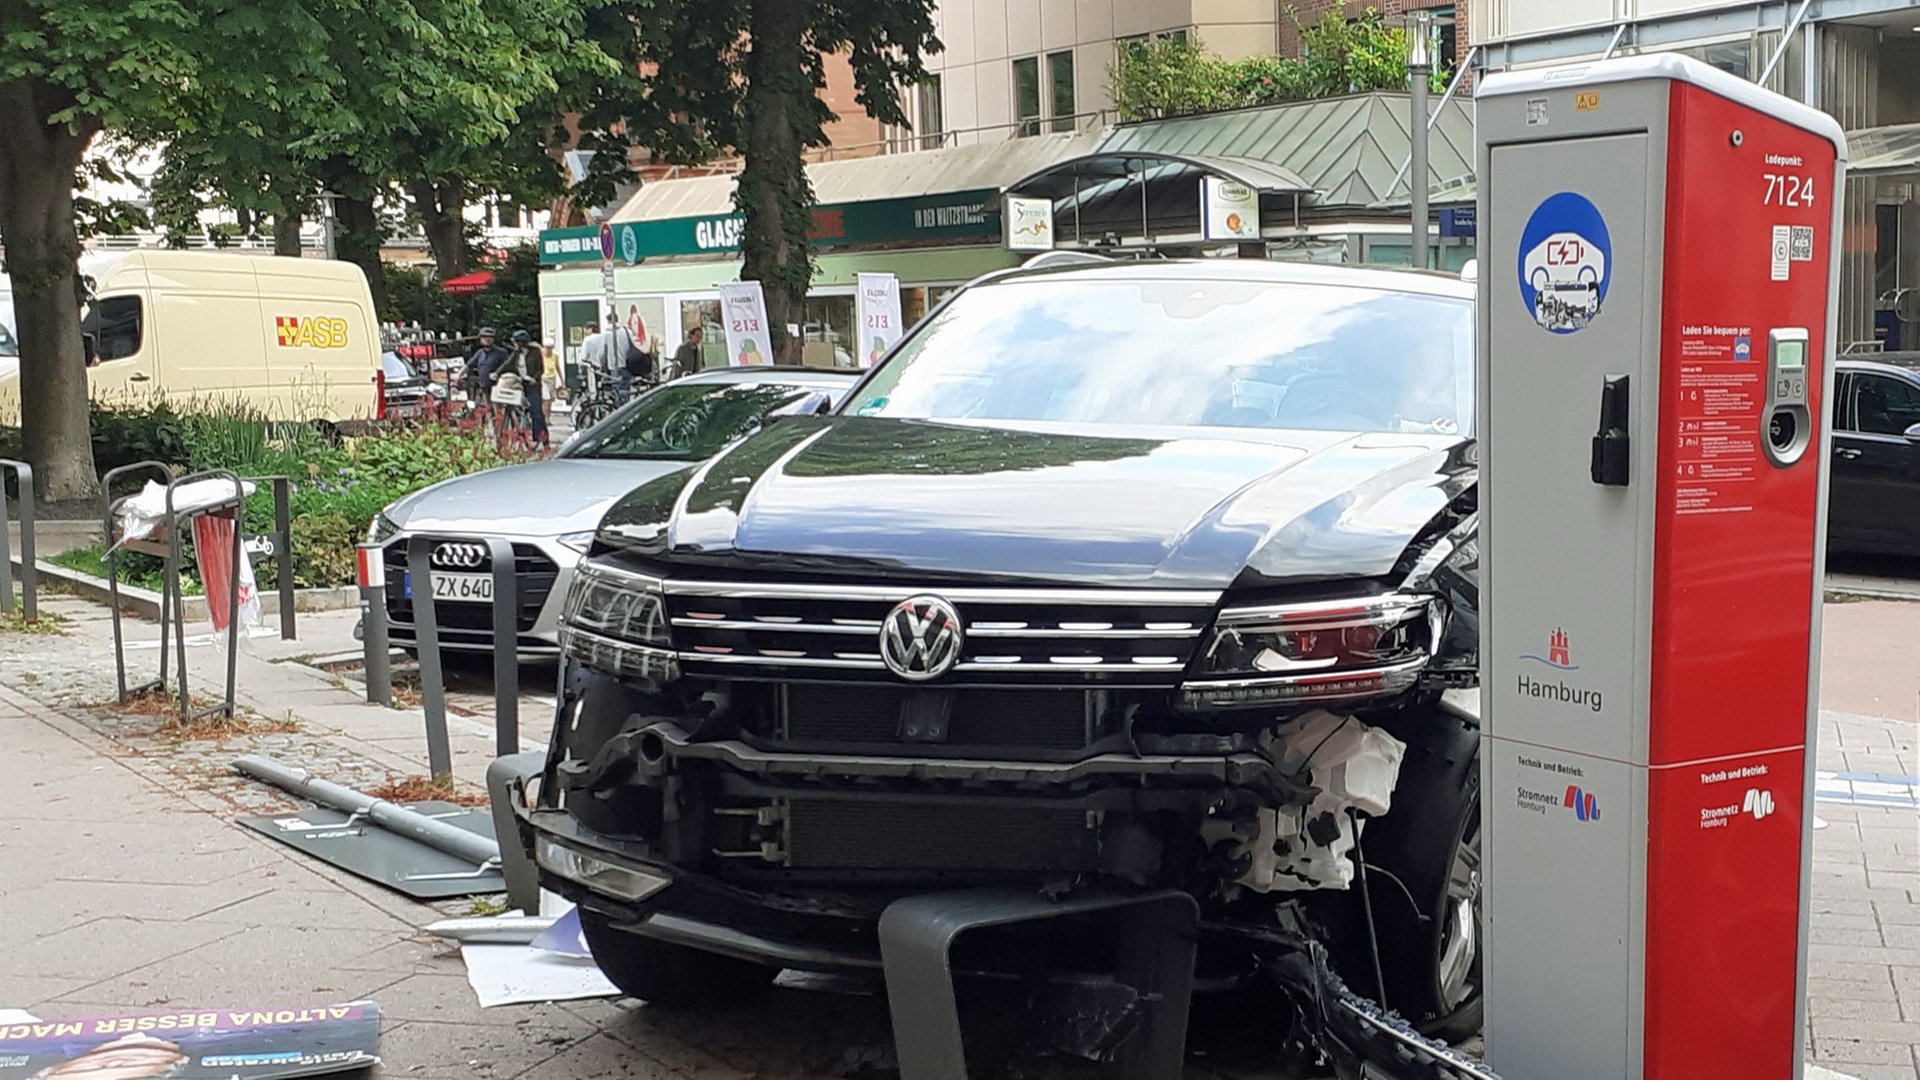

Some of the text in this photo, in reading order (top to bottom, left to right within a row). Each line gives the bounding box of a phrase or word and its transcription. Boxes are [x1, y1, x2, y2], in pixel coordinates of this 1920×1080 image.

[1763, 173, 1814, 207] 7124
[923, 208, 936, 228] DER
[295, 316, 348, 348] ASB
[1682, 325, 1702, 335] Laden
[1703, 325, 1713, 335] Sie
[436, 577, 492, 598] ZX 640
[1517, 674, 1602, 712] Hamburg
[1517, 756, 1584, 777] Technik und Betrieb:
[1701, 771, 1727, 783] Technik
[1728, 768, 1741, 779] und
[1517, 787, 1558, 806] Stromnetz
[1517, 799, 1546, 815] Hamburg
[1701, 804, 1739, 819] Stromnetz
[95, 1012, 217, 1034] BESSER
[229, 1007, 351, 1025] ALTONA
